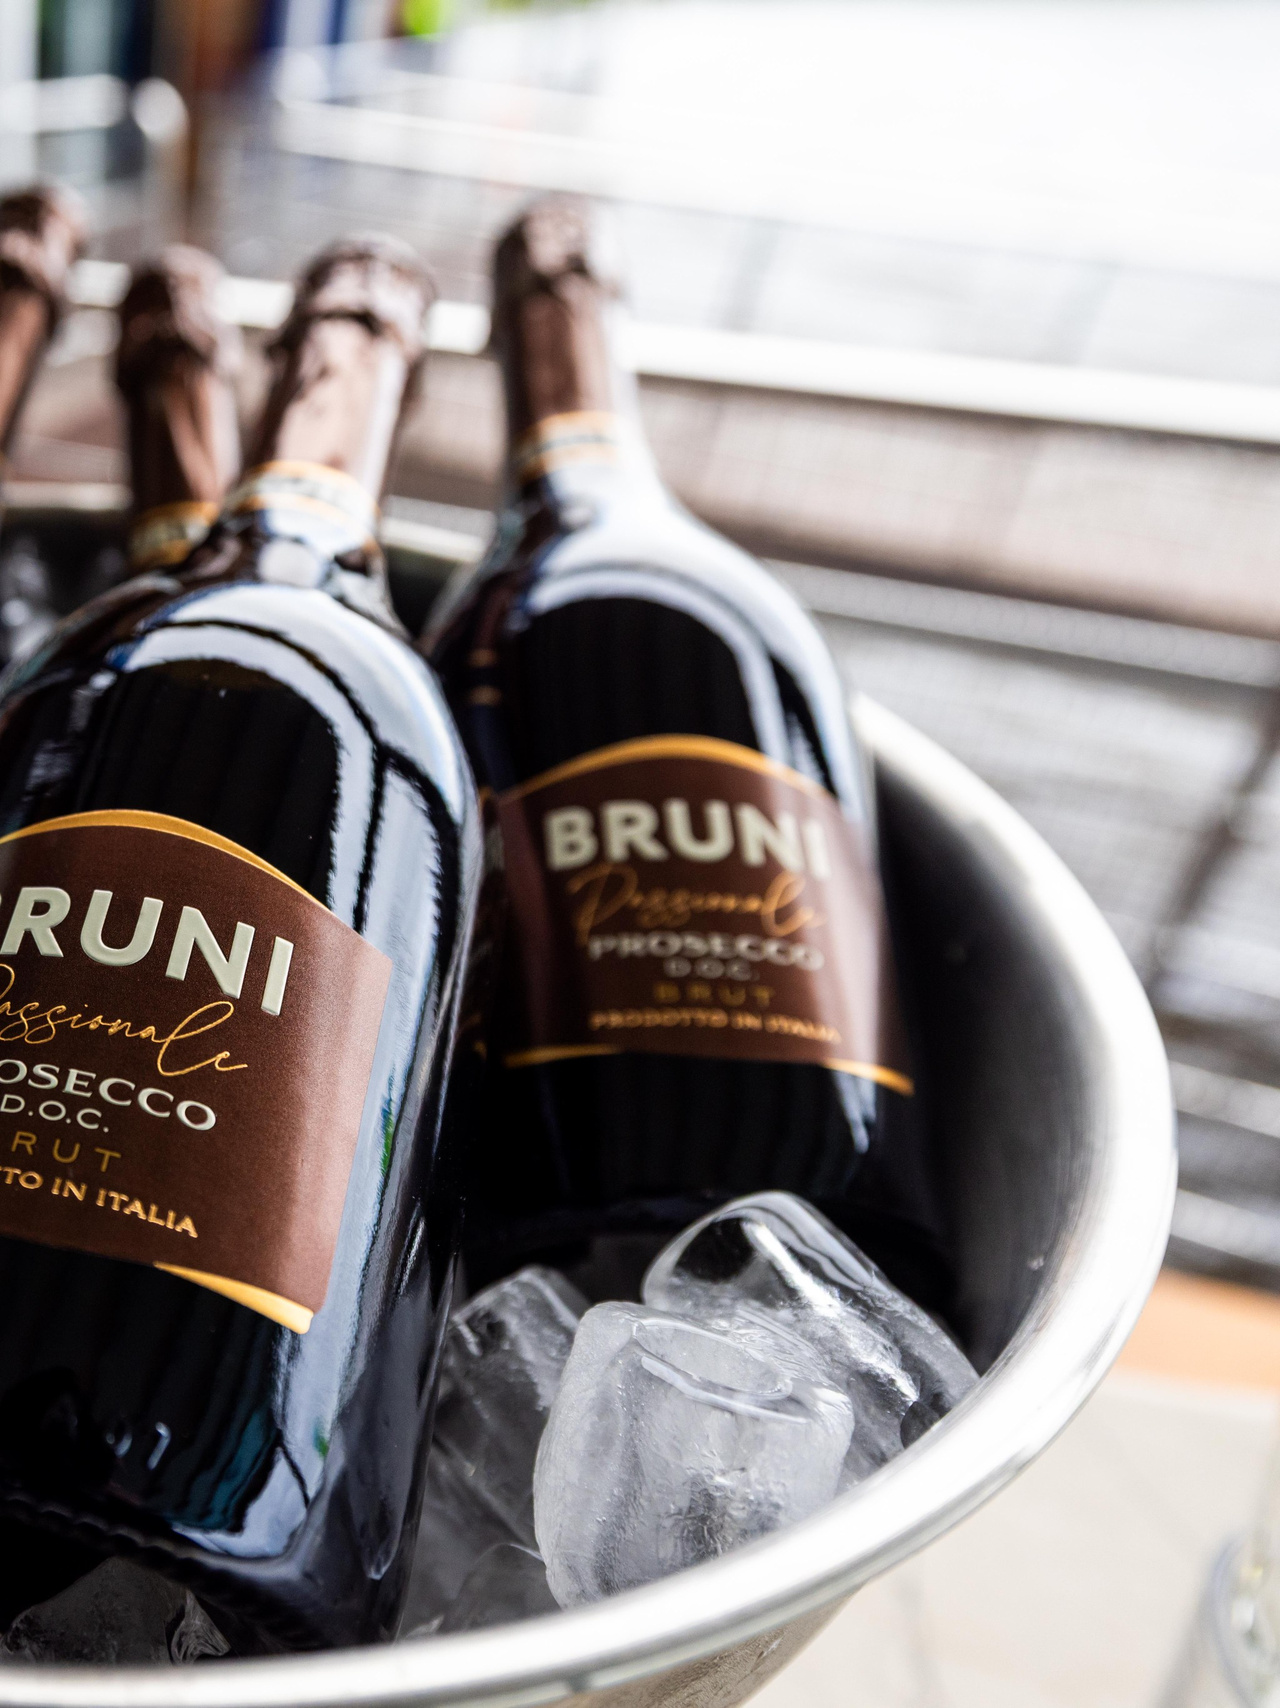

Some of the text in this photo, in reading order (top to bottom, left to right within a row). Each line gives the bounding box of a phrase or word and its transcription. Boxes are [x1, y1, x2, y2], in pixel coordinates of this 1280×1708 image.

[544, 798, 832, 881] BRUNI
[0, 1094, 110, 1133] D.O.C.
[51, 1177, 89, 1202] IN
[96, 1189, 199, 1239] ITALIA
